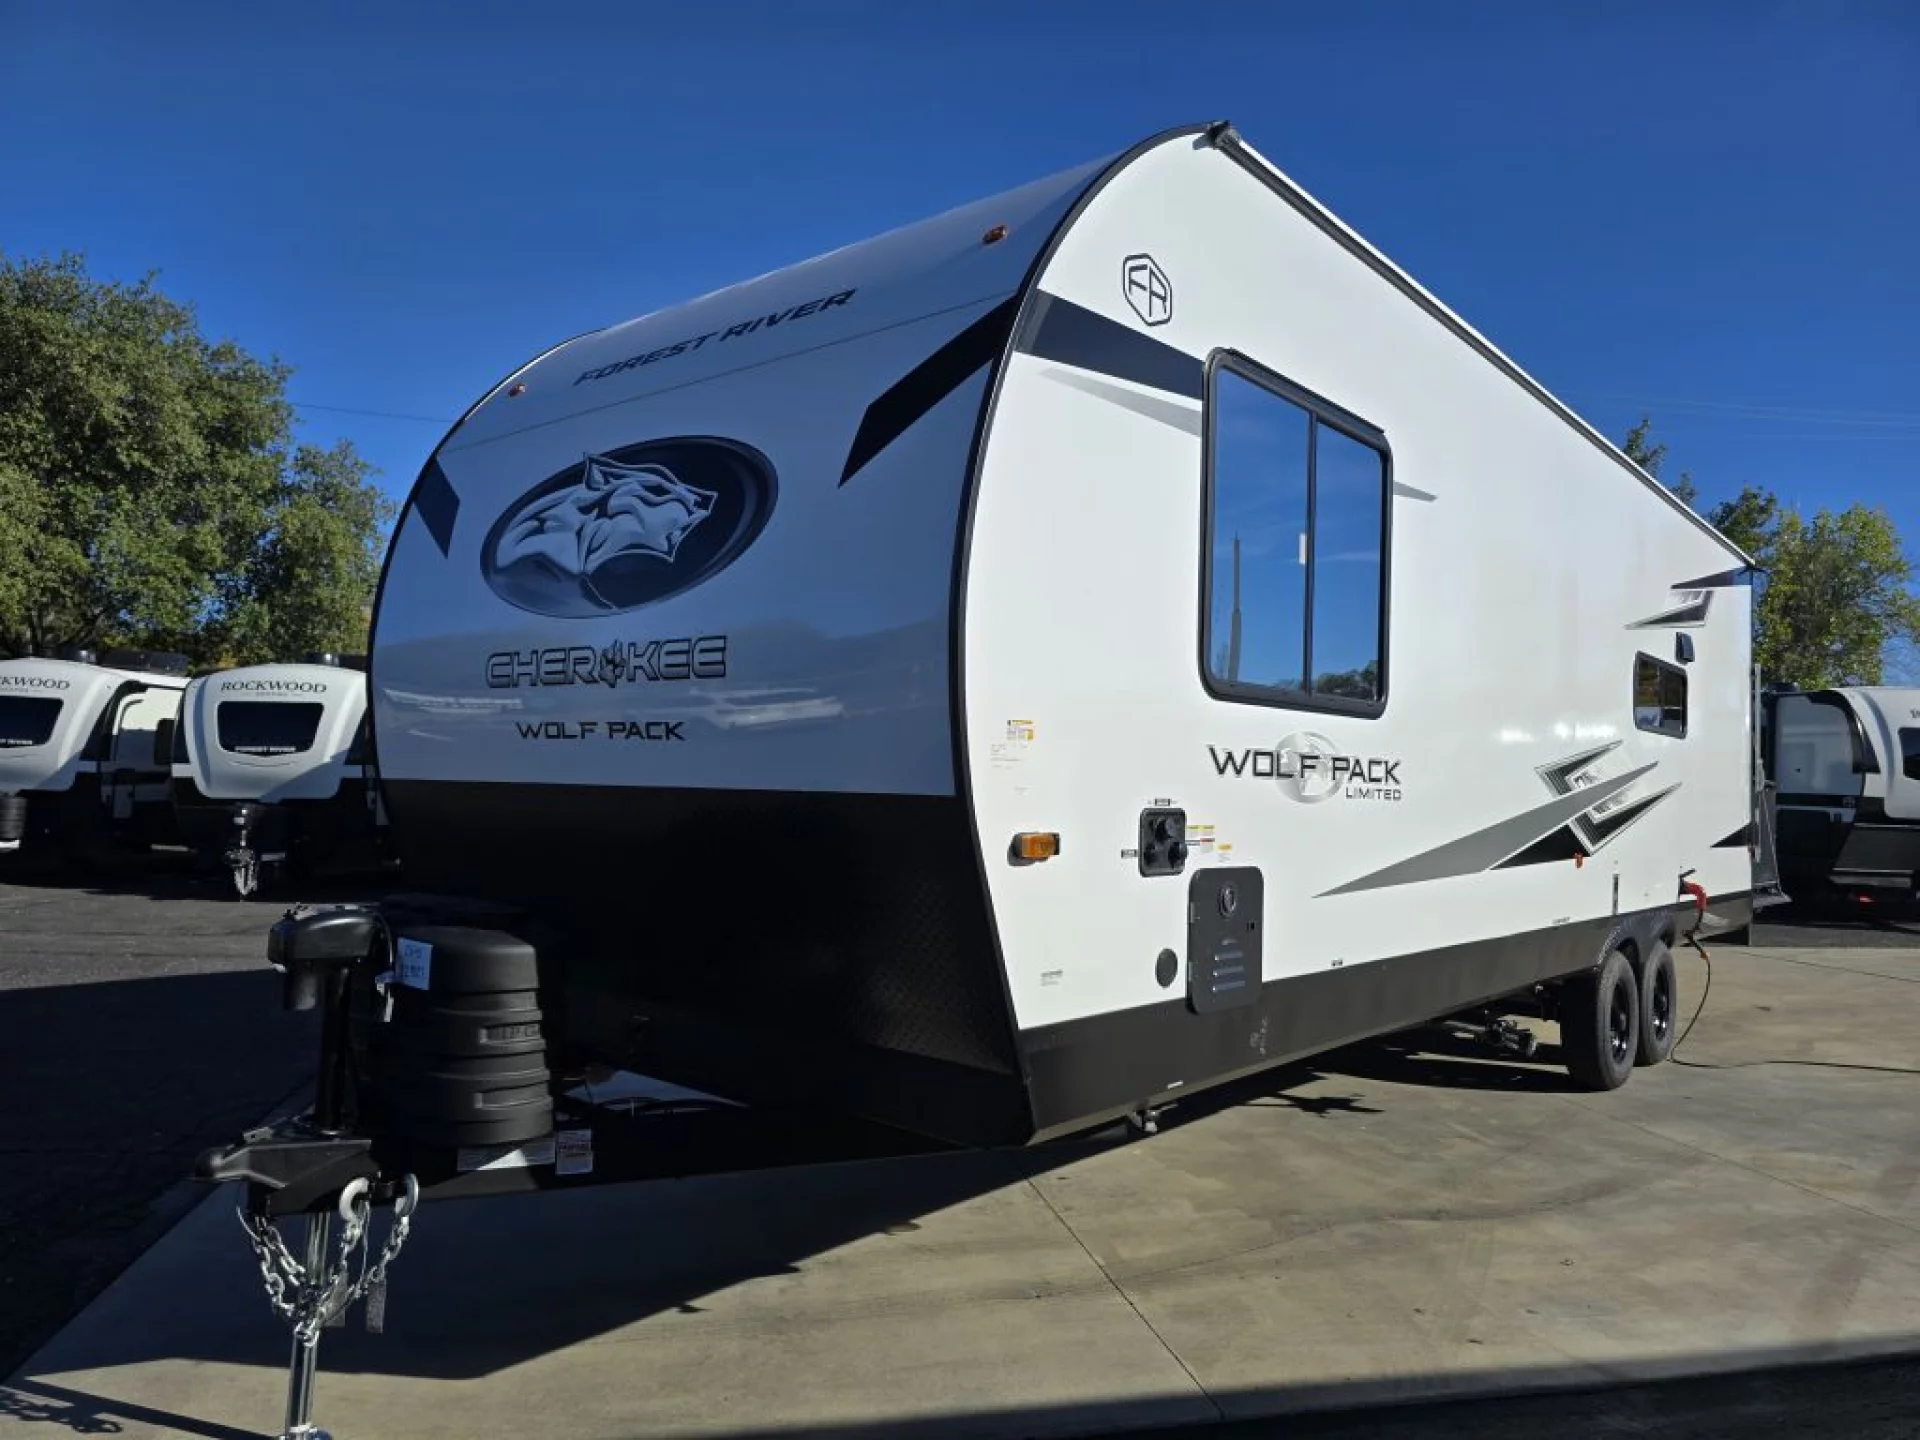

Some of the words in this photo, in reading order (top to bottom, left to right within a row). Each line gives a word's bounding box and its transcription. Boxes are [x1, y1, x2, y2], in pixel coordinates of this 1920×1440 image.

[573, 331, 719, 386] FOREST
[719, 288, 857, 342] RIVER
[486, 635, 727, 688] CHEROKEE
[0, 676, 70, 690] KWOOD
[221, 681, 327, 692] ROCKWOOD
[516, 721, 598, 740] WOLF
[608, 721, 686, 741] PACK
[1206, 744, 1319, 779] WOLF
[1331, 756, 1401, 784] PACK
[1346, 787, 1402, 800] LIMITED
